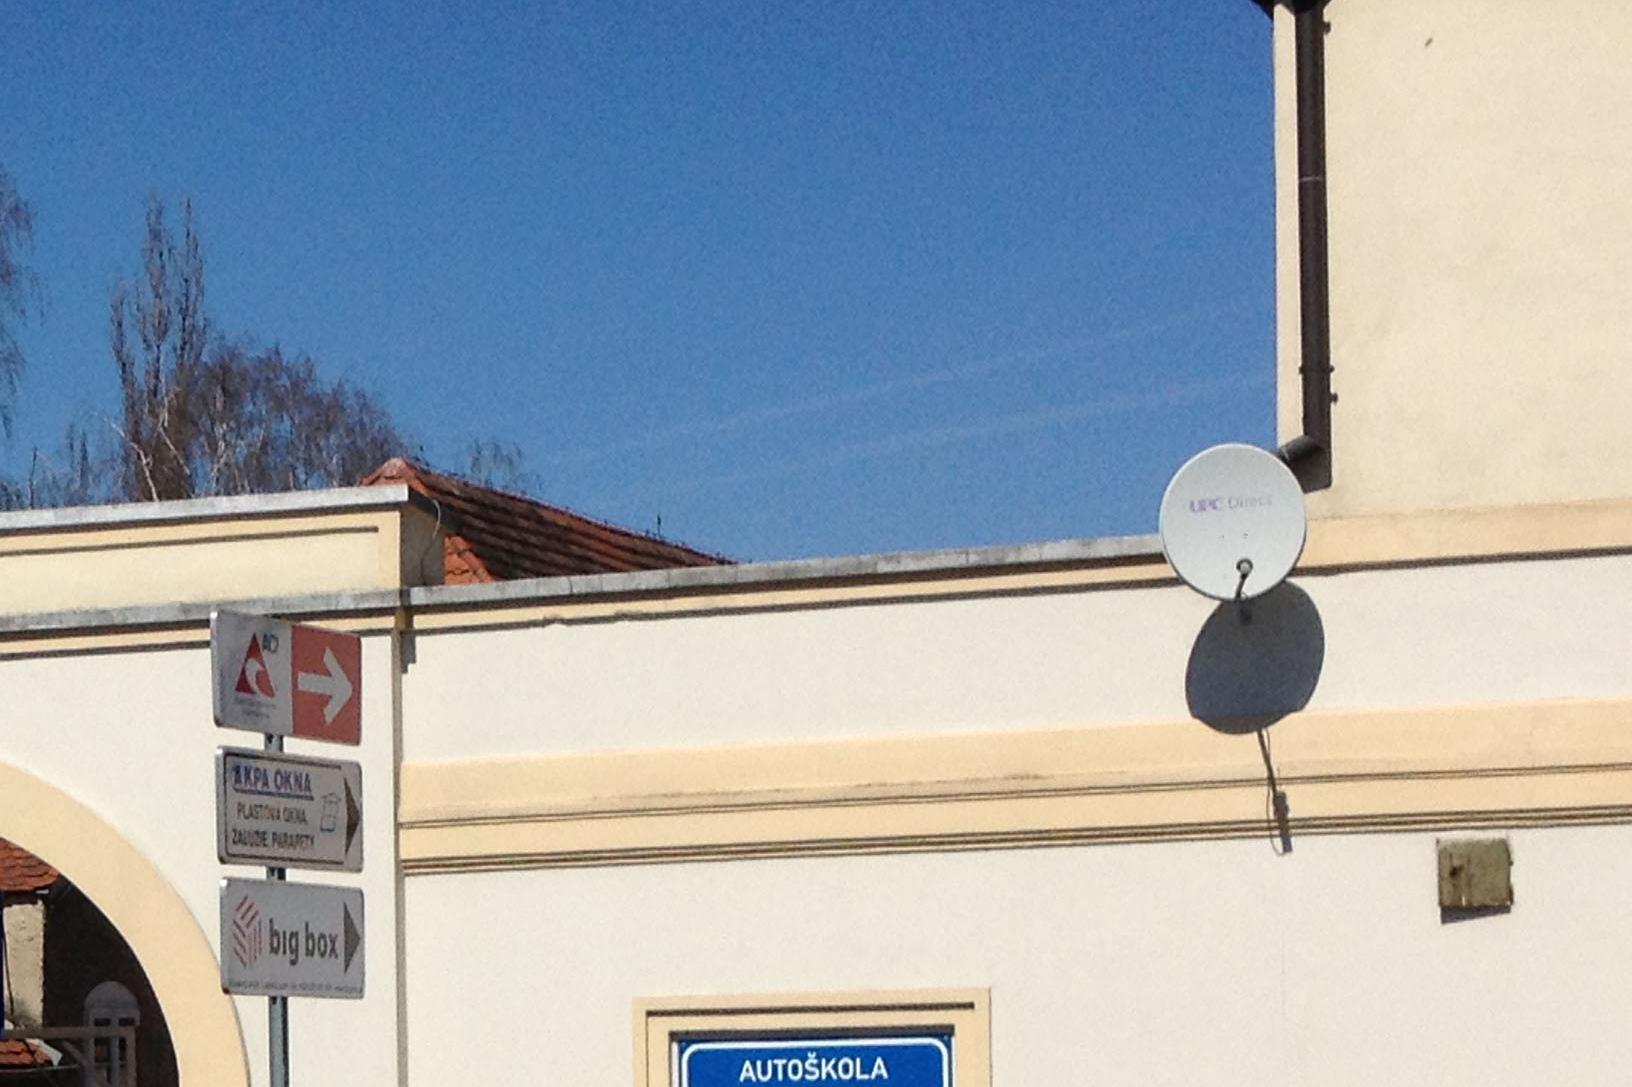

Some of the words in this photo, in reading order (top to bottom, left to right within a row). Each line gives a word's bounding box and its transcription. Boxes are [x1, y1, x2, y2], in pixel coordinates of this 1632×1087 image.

[274, 768, 312, 793] OKNA
[269, 917, 299, 967] big
[305, 921, 338, 959] box
[739, 1052, 889, 1083] AUTOŠKOLA
